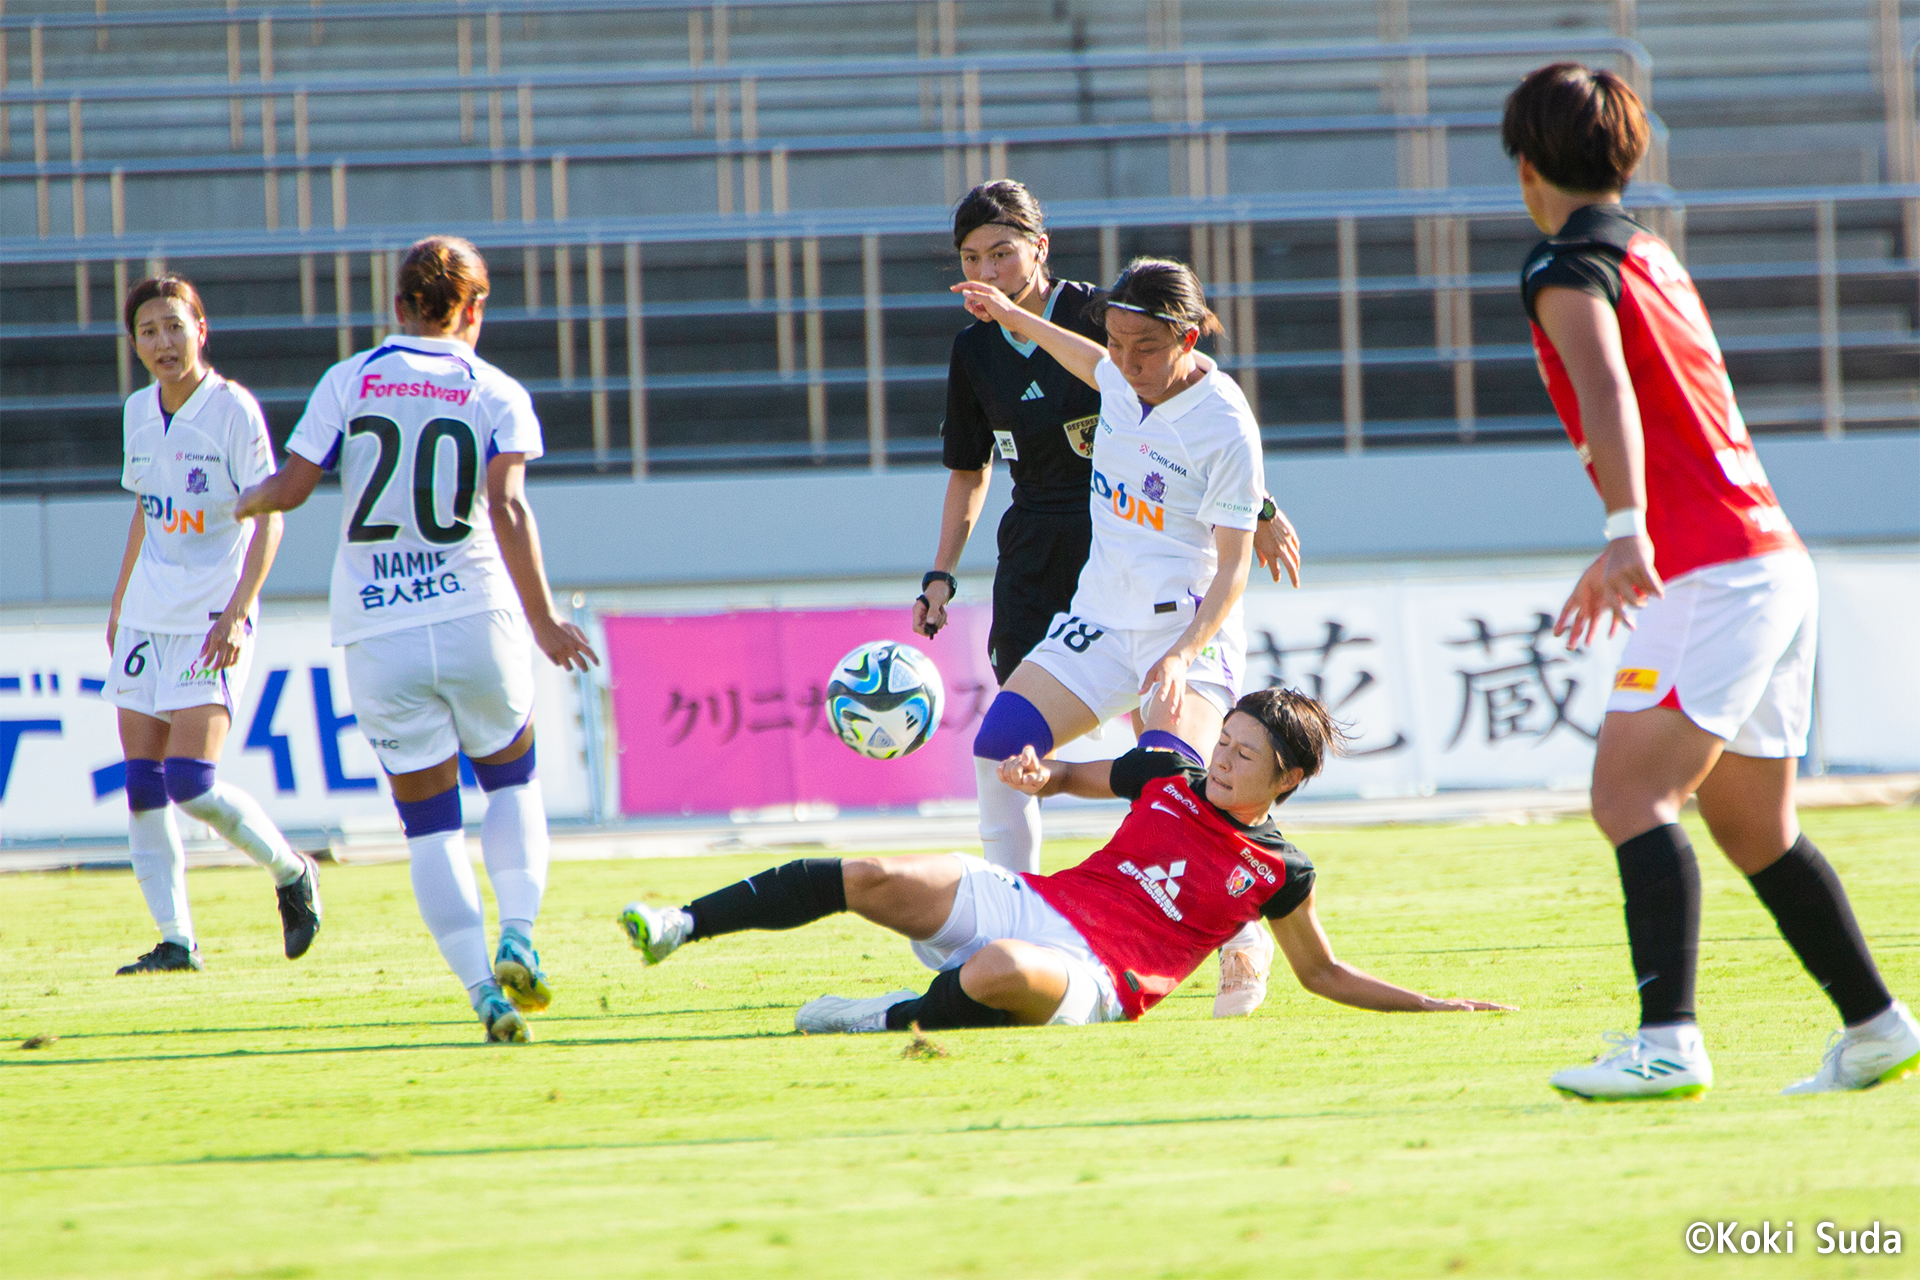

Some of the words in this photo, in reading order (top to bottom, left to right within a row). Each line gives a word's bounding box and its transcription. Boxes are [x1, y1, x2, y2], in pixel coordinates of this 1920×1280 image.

[360, 374, 471, 406] Forestway
[184, 452, 221, 463] ICHIKAWA
[1149, 450, 1187, 478] ICHIKAWA
[347, 415, 478, 544] 20
[1091, 469, 1164, 532] DION
[1216, 501, 1253, 512] HIROSHIMA
[359, 573, 466, 610] 合人社G.
[1049, 616, 1104, 654] 18
[124, 641, 150, 677] 6
